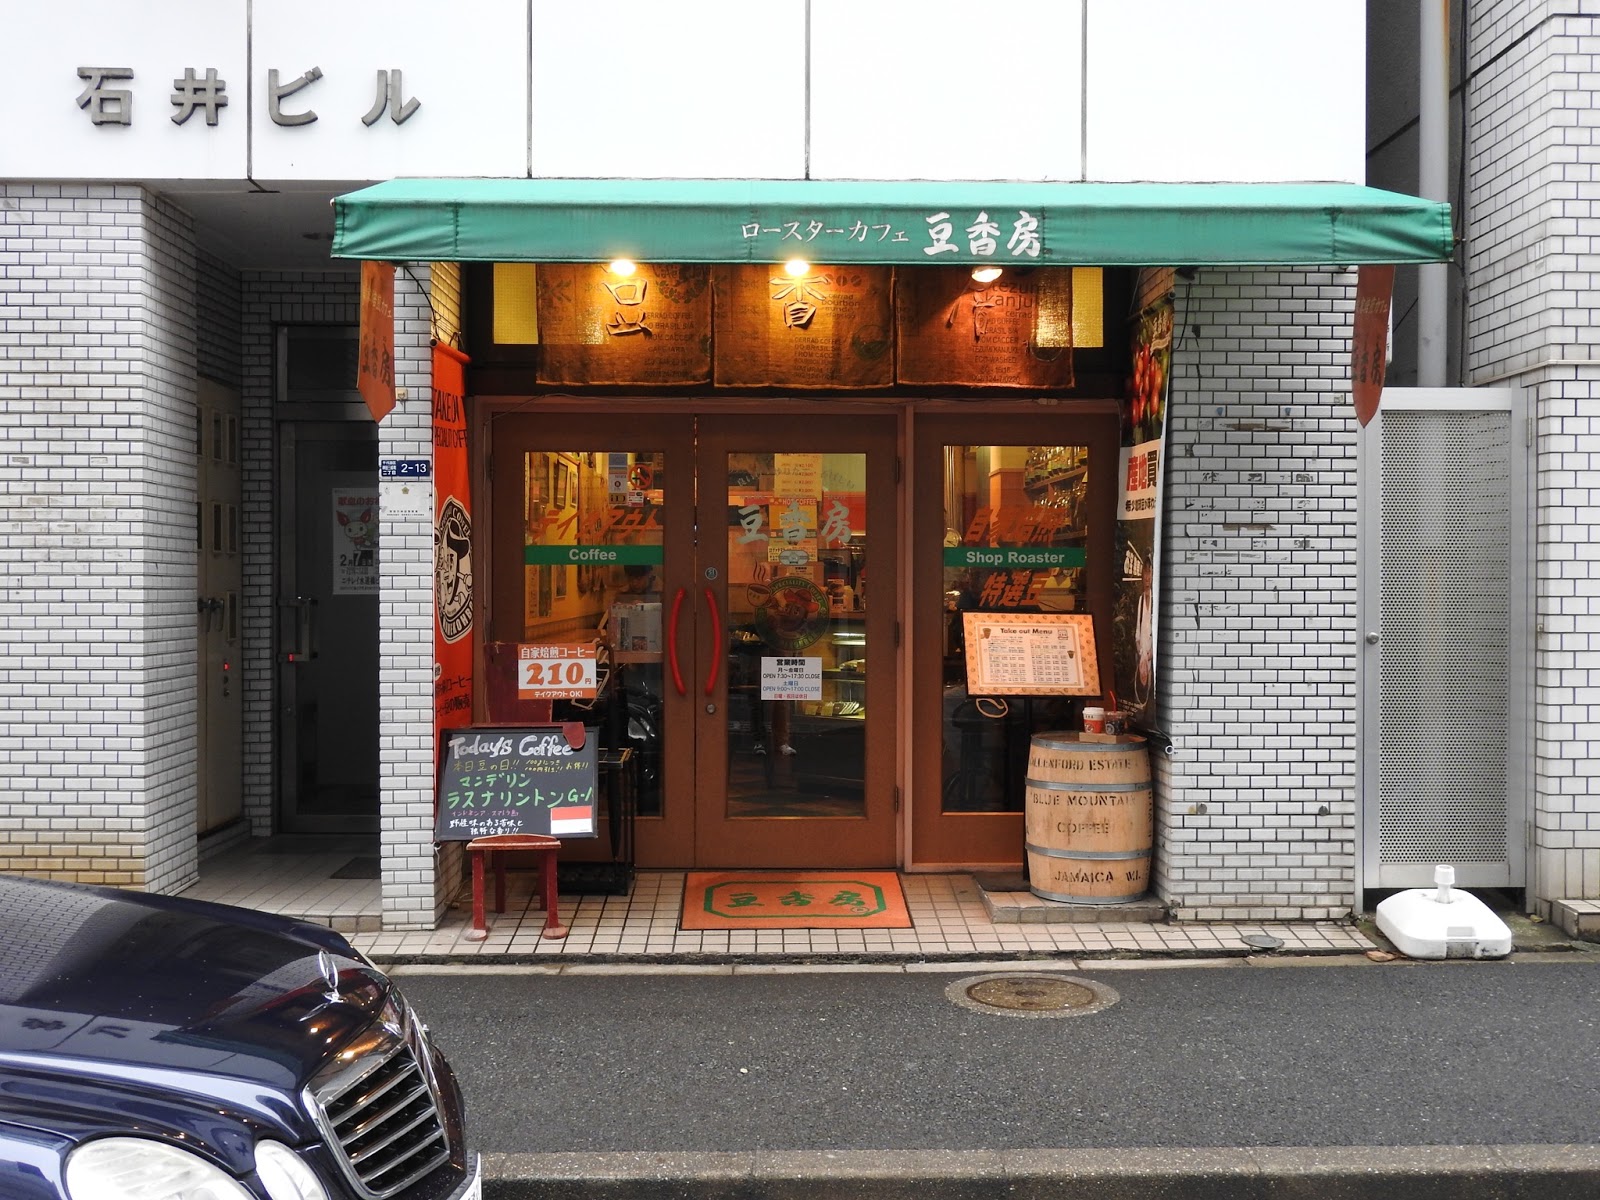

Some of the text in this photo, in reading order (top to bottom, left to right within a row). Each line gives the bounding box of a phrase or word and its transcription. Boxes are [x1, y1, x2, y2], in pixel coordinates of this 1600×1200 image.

[75, 66, 421, 127] 石井ビル
[741, 210, 1042, 257] ロースターカフェ 豆香房
[401, 463, 427, 473] 2-13
[1126, 449, 1160, 491] 産地買
[735, 500, 853, 545] 豆香房
[568, 548, 617, 561] Coffee
[966, 551, 1065, 565] Shop Roaster
[520, 647, 595, 659] 自家焙煎コーヒー
[519, 734, 574, 757] Coffee
[459, 773, 532, 788] マンデリン
[1055, 870, 1114, 883] JAMAICA
[725, 890, 866, 907] 豆香房
